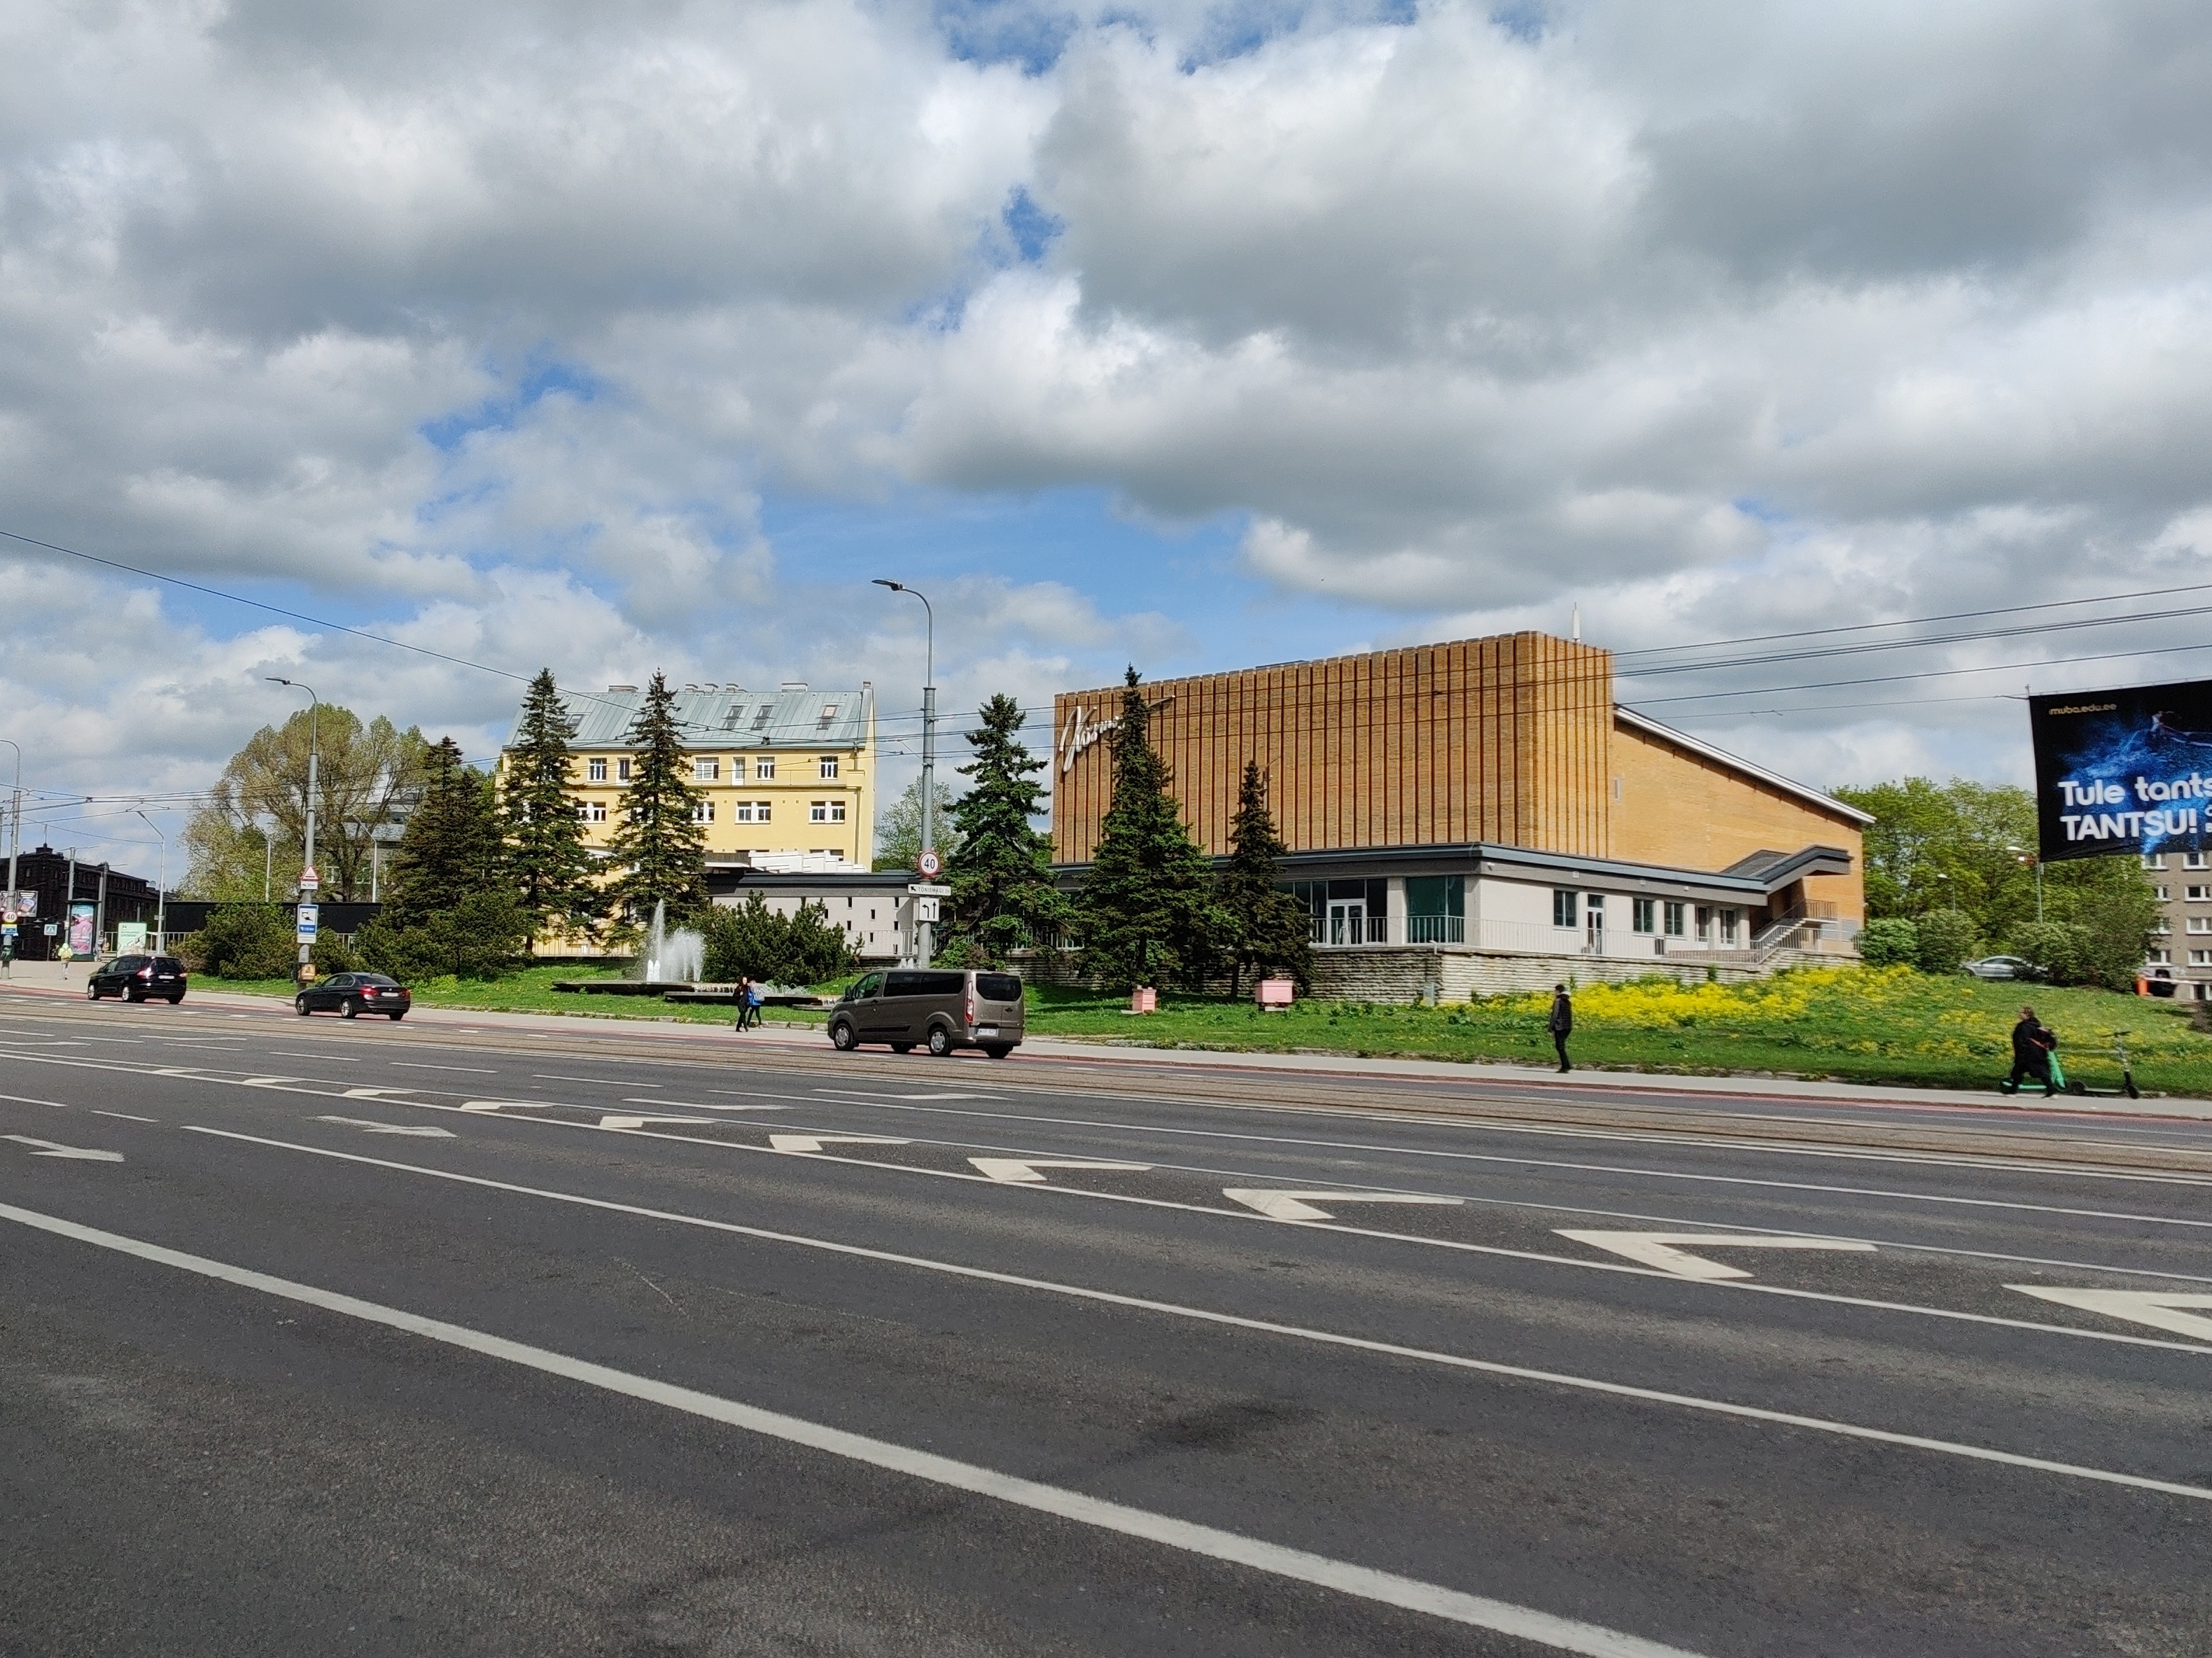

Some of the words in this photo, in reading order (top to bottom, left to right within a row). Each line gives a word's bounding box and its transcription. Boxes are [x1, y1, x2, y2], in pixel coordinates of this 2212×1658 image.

[2049, 704, 2118, 715] muba.edu.ee
[2057, 779, 2126, 806] Tule
[2059, 808, 2197, 840] TANTSU!
[924, 858, 935, 869] 40
